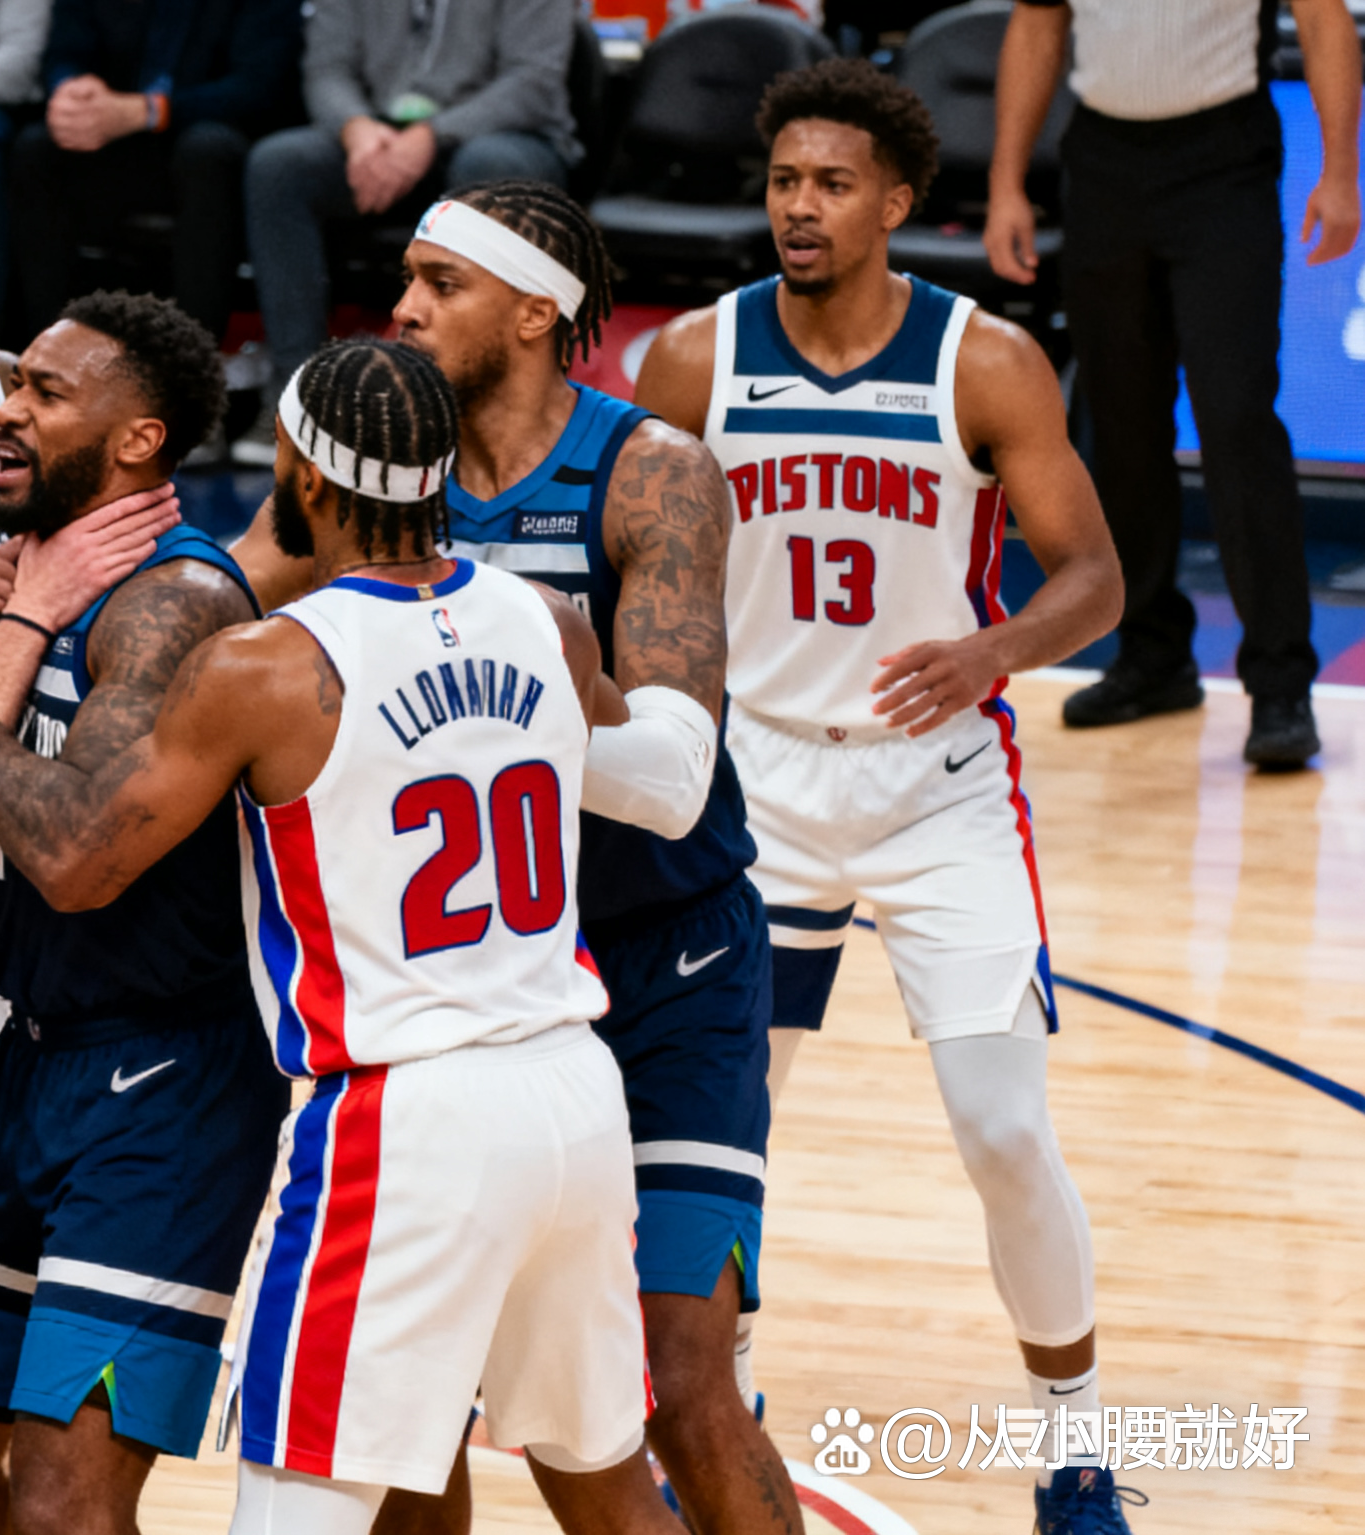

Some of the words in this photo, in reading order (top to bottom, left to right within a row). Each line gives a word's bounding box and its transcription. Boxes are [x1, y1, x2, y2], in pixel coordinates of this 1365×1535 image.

[726, 453, 941, 529] PISTONS
[787, 535, 876, 626] 13
[392, 759, 566, 960] 20
